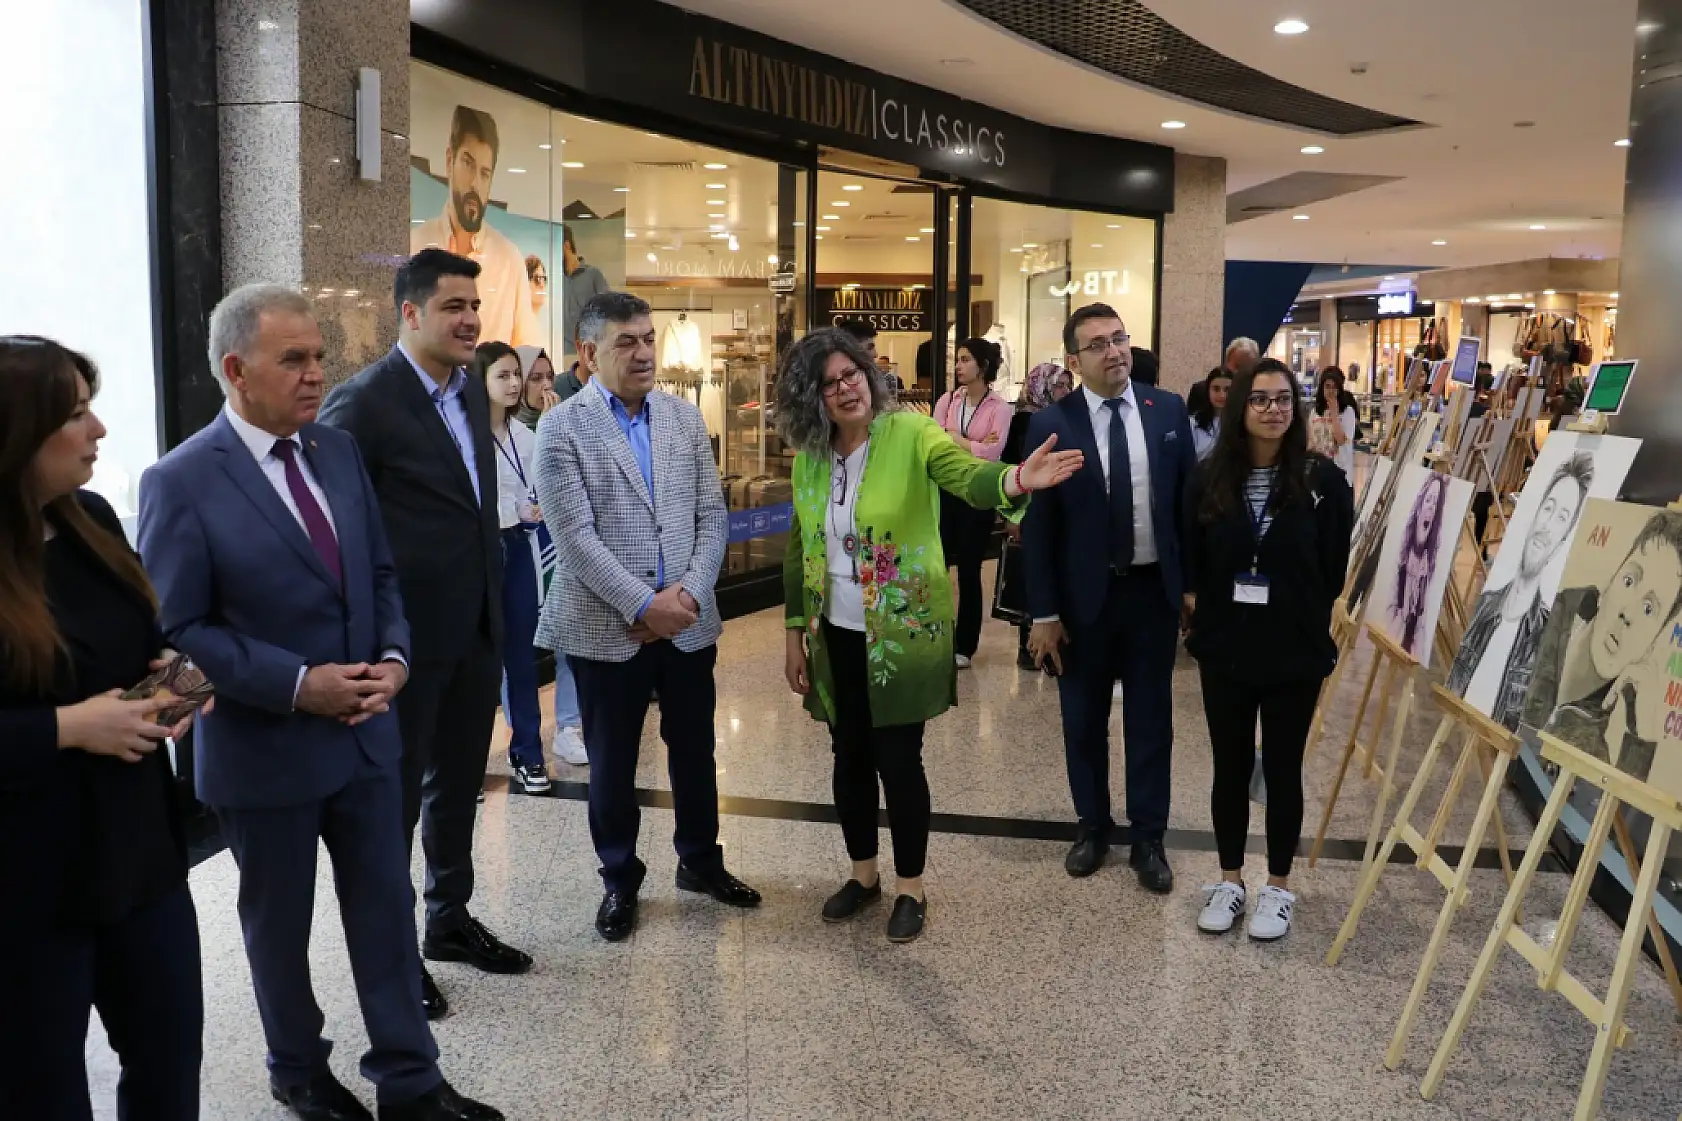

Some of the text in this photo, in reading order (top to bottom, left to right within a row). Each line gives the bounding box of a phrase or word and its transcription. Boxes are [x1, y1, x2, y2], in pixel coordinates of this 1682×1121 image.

[689, 36, 1006, 167] ALTINYILDIZ CLASSICS
[831, 290, 922, 310] ALTINYILDIZ
[1586, 525, 1613, 548] AN
